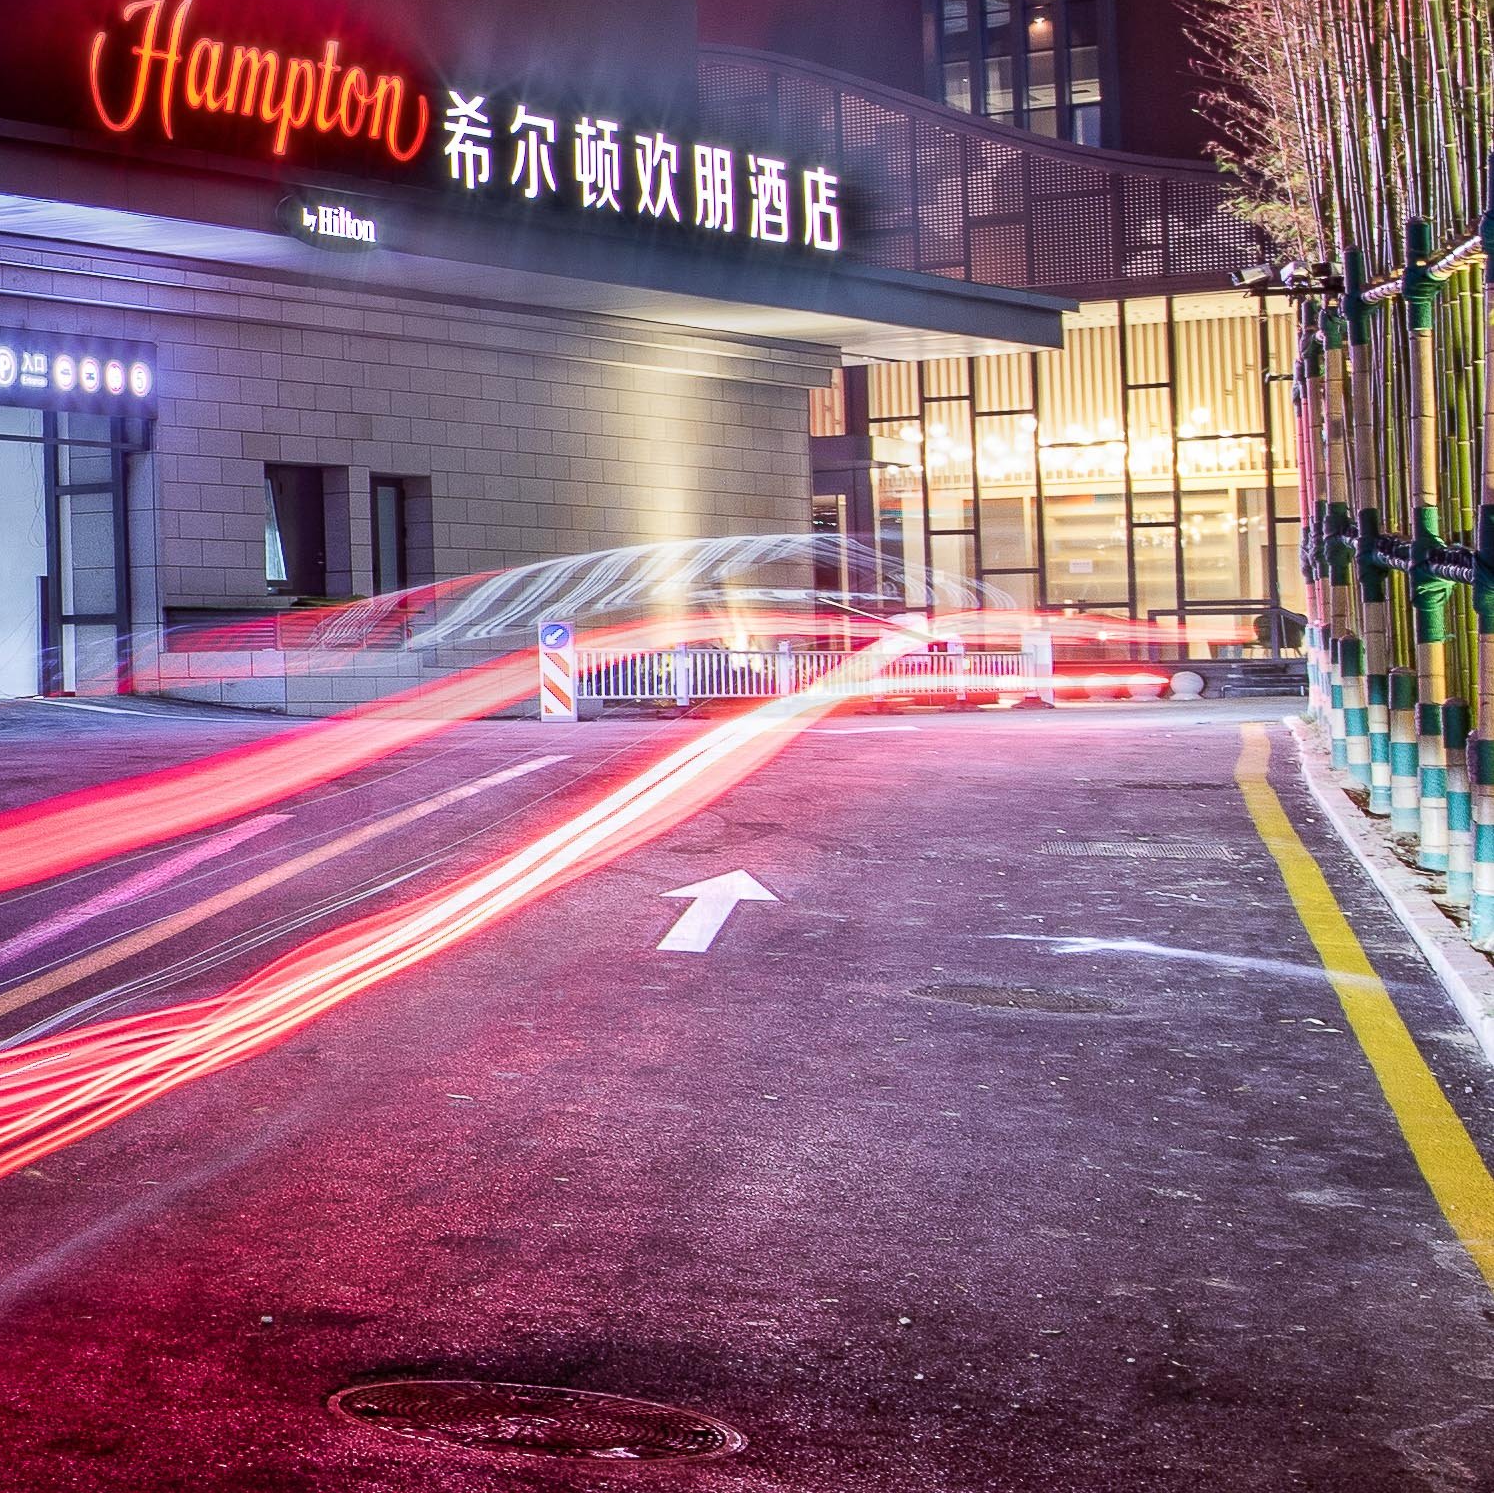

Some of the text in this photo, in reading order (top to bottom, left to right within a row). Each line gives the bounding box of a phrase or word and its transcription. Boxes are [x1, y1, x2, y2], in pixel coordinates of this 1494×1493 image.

[443, 90, 840, 252] 希尔顿欢朋酒店
[302, 206, 376, 242] by Hilton
[22, 352, 46, 373] 入口
